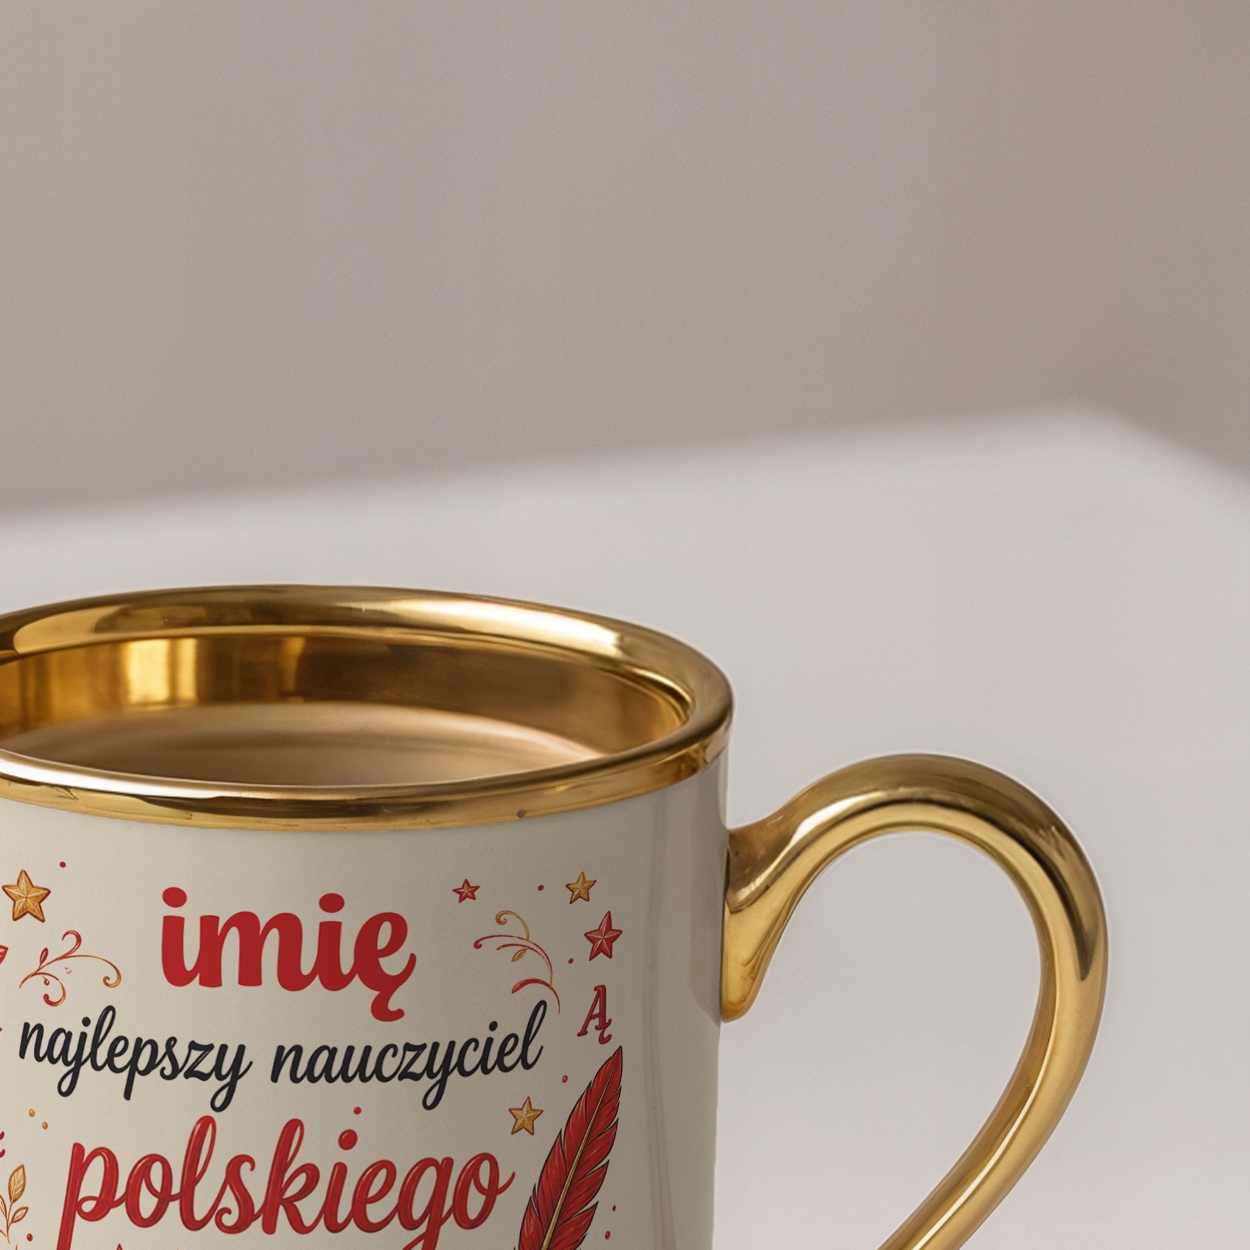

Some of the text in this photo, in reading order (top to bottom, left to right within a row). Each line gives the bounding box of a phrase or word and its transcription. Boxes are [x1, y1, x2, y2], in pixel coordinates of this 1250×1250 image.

[161, 886, 417, 1023] imię
[18, 1000, 548, 1113] najlepszy nauczyciel
[576, 983, 613, 1046] Ą
